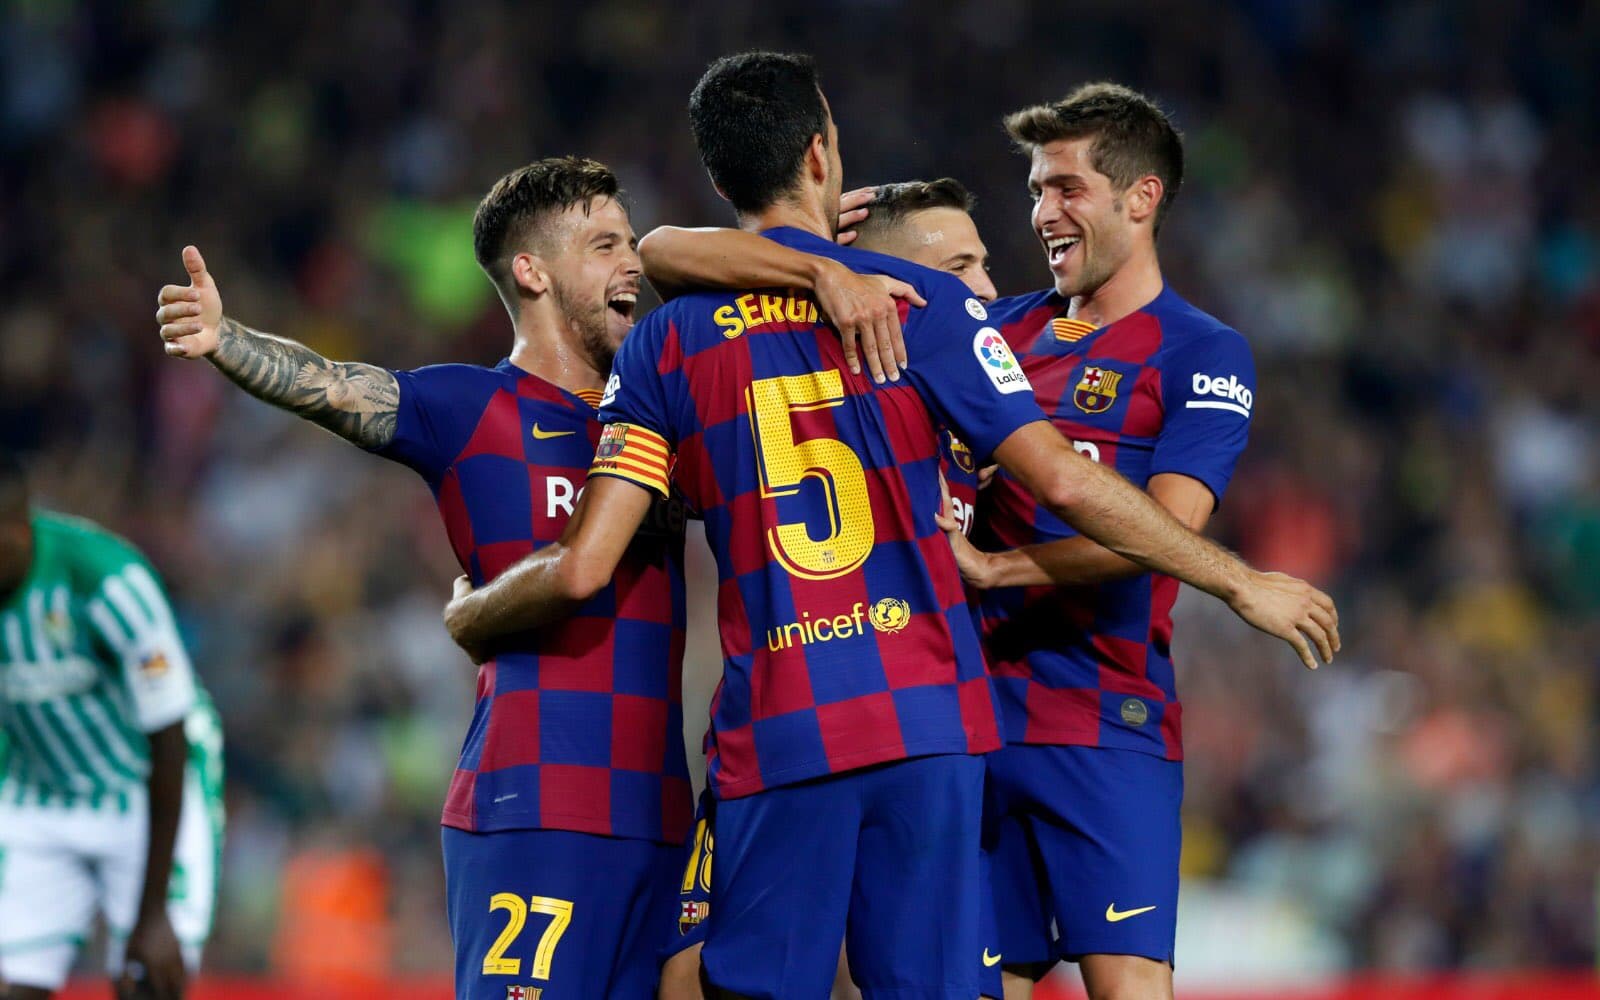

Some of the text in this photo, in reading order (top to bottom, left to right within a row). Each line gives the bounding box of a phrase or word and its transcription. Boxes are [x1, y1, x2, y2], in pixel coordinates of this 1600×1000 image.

[1192, 372, 1253, 411] beko
[745, 368, 875, 580] 5
[767, 602, 865, 653] unicef
[482, 892, 574, 981] 27
